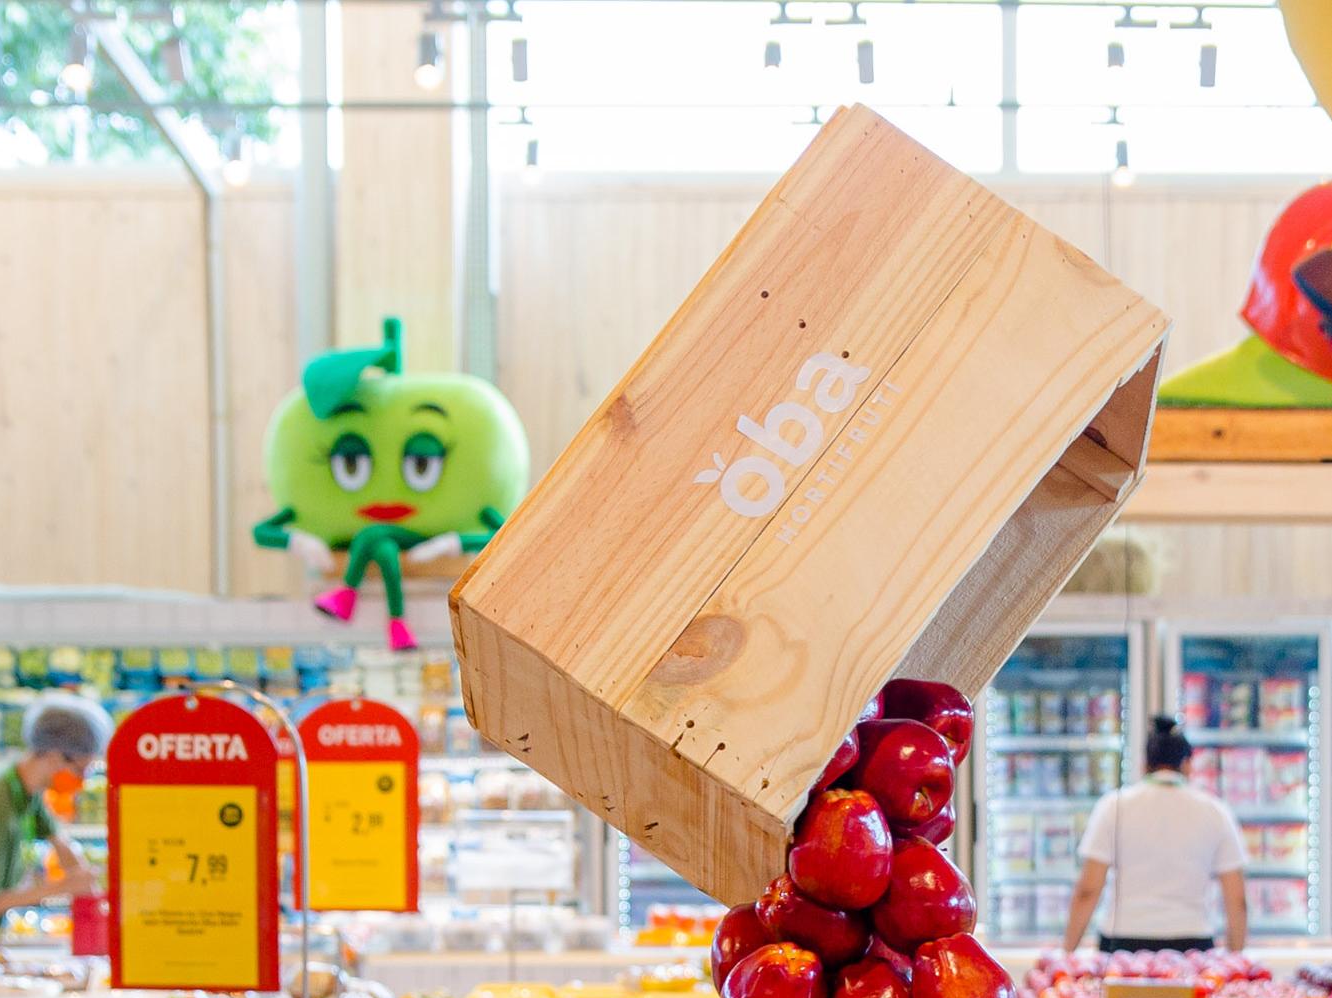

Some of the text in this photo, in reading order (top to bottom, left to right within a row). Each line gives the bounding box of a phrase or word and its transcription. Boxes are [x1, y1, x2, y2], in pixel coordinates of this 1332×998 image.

[775, 380, 905, 545] HORTIFRUTI
[136, 733, 249, 761] OFERTA
[317, 724, 402, 747] OFERTA
